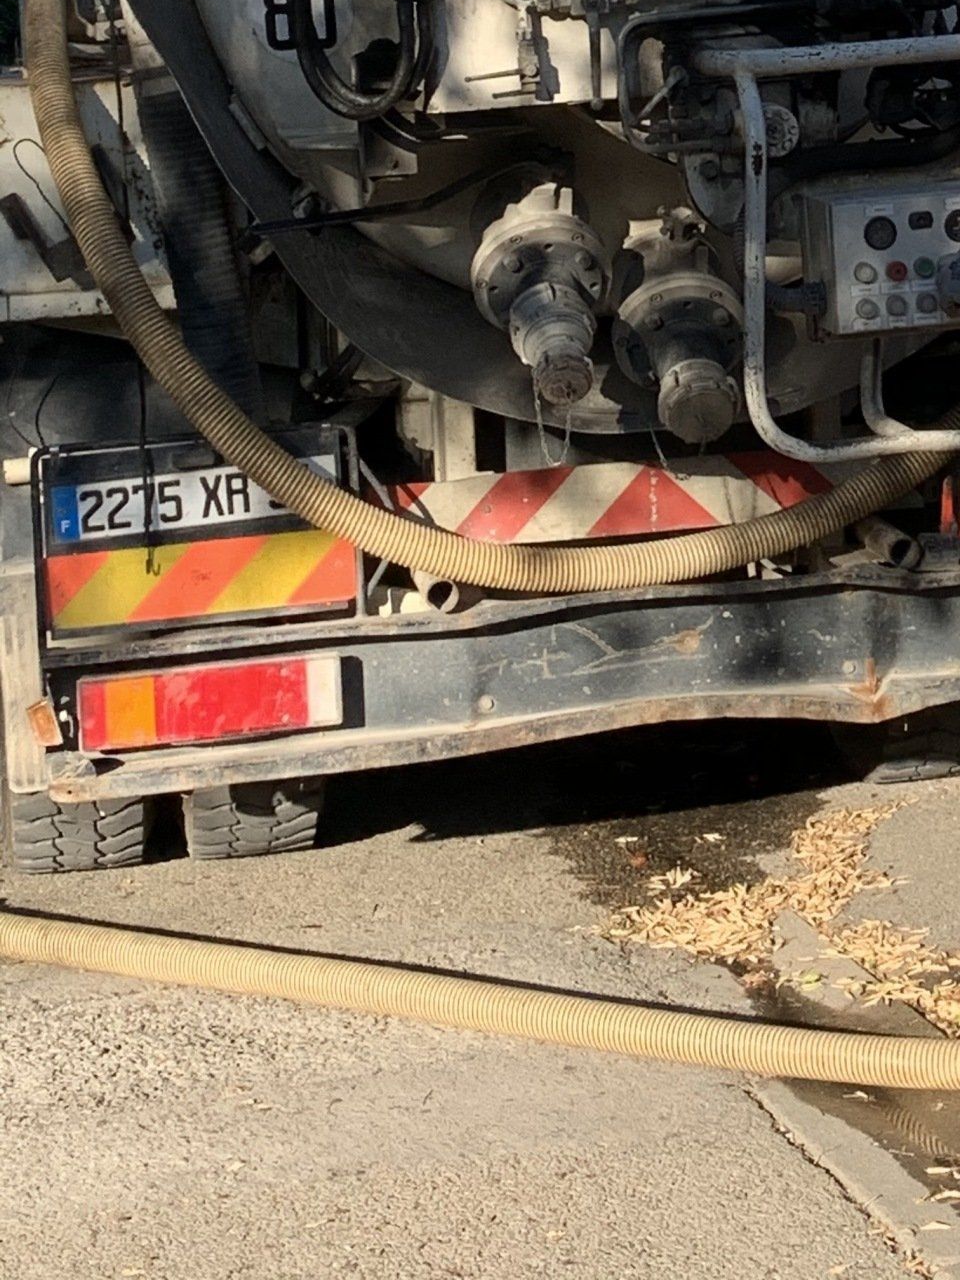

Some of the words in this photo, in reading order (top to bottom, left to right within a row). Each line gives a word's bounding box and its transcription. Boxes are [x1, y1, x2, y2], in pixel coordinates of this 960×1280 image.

[79, 479, 183, 532] 2275
[199, 473, 251, 518] XR
[60, 520, 71, 534] F
